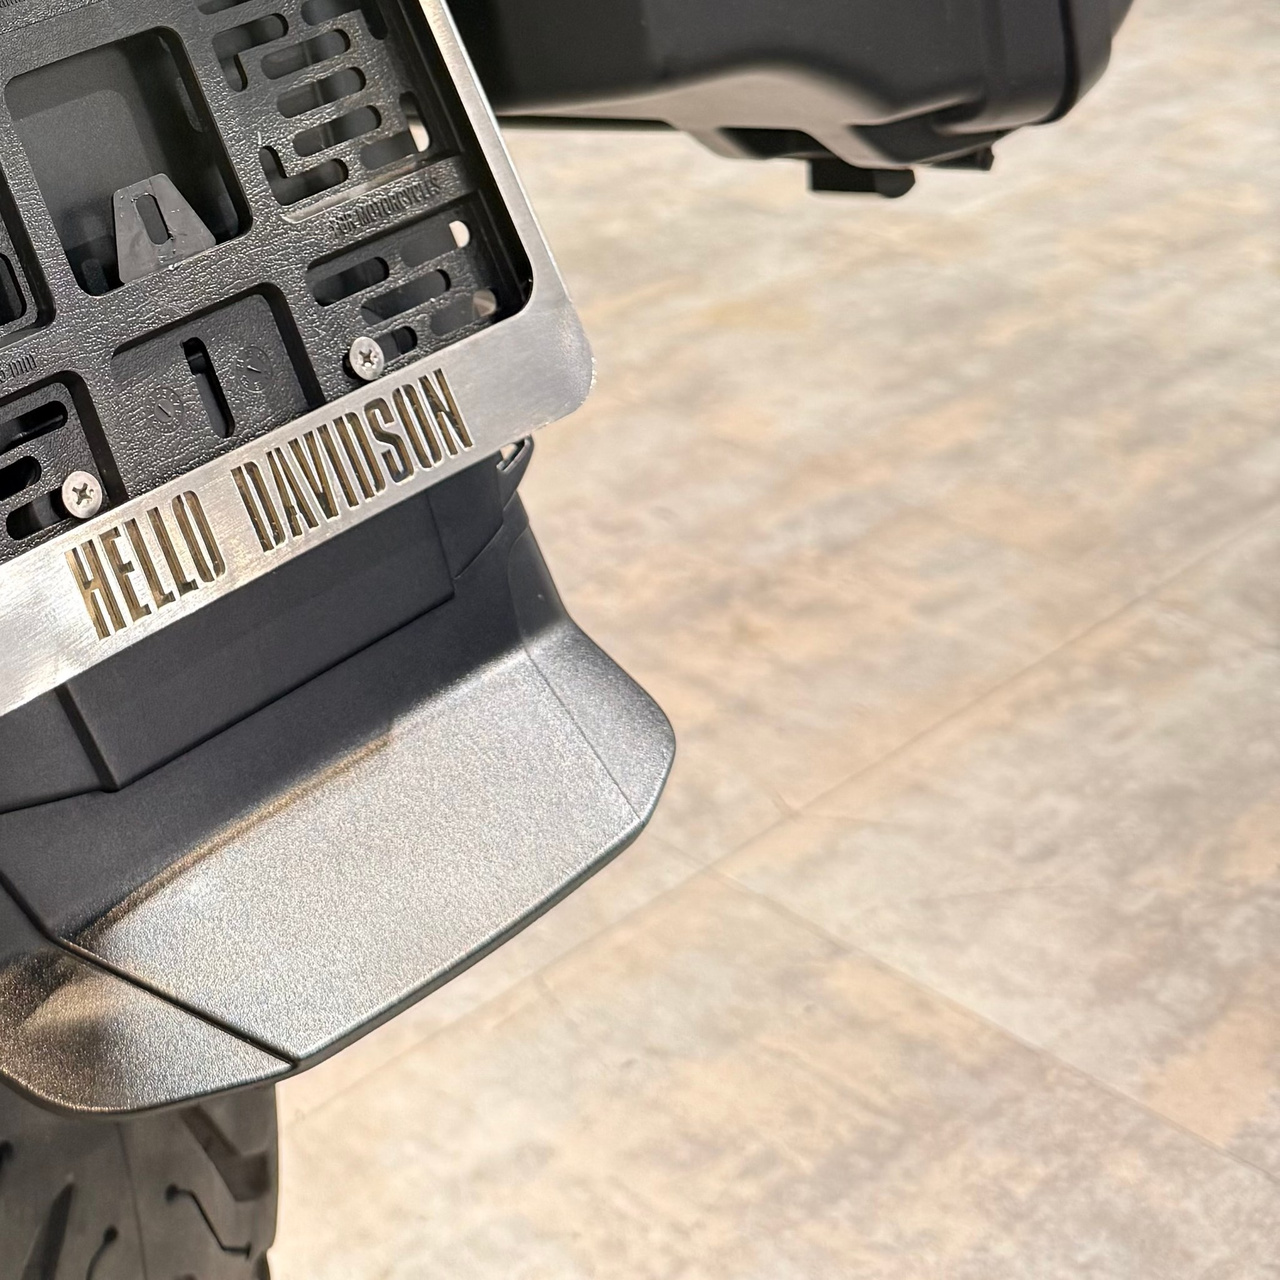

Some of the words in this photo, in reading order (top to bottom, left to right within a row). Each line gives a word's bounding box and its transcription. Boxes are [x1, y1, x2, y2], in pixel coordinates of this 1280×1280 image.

[9, 353, 38, 378] mm
[64, 490, 226, 641] HELLO
[230, 368, 473, 553] DAVIDSON
